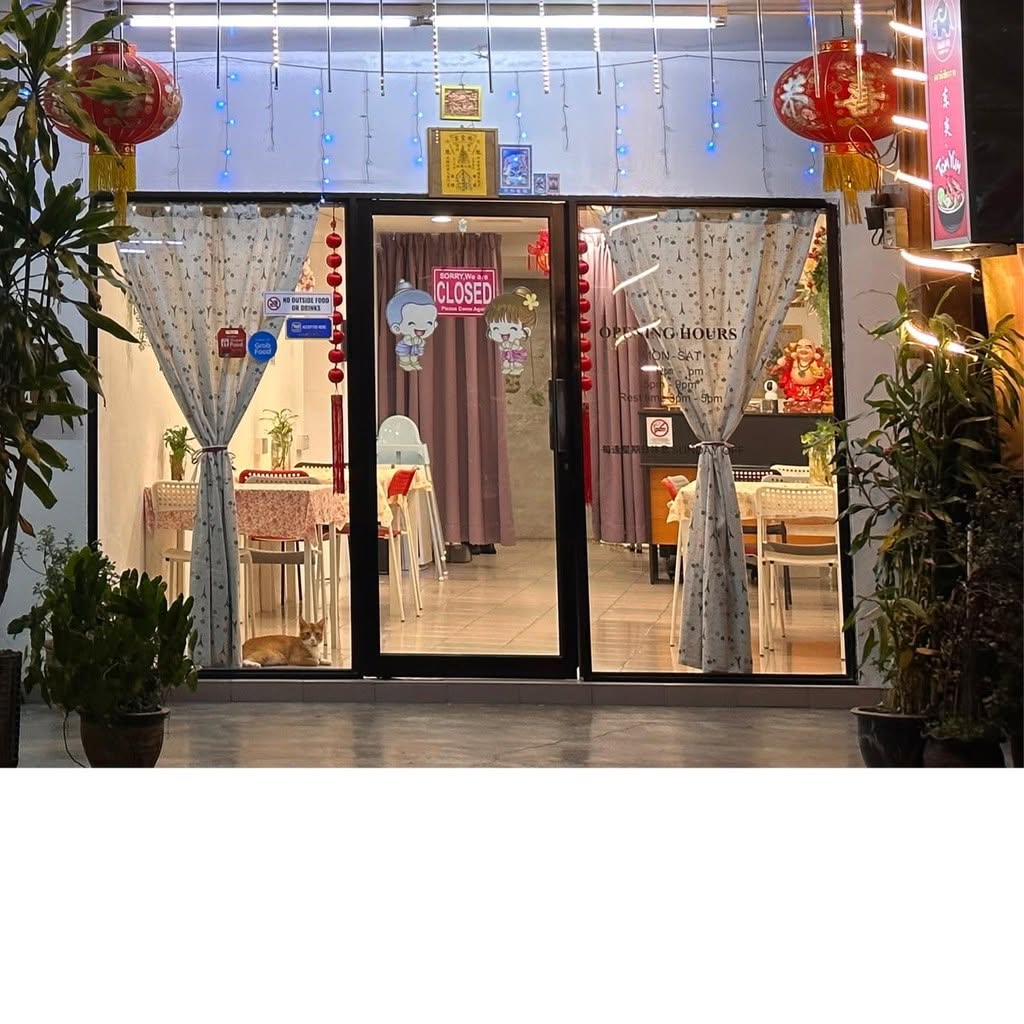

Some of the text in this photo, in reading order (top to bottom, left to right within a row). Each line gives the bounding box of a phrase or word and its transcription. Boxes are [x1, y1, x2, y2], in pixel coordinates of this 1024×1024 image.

[436, 281, 492, 305] CLOSED
[680, 326, 738, 340] HOURS
[677, 350, 702, 361] SAT
[701, 392, 723, 405] 5pm
